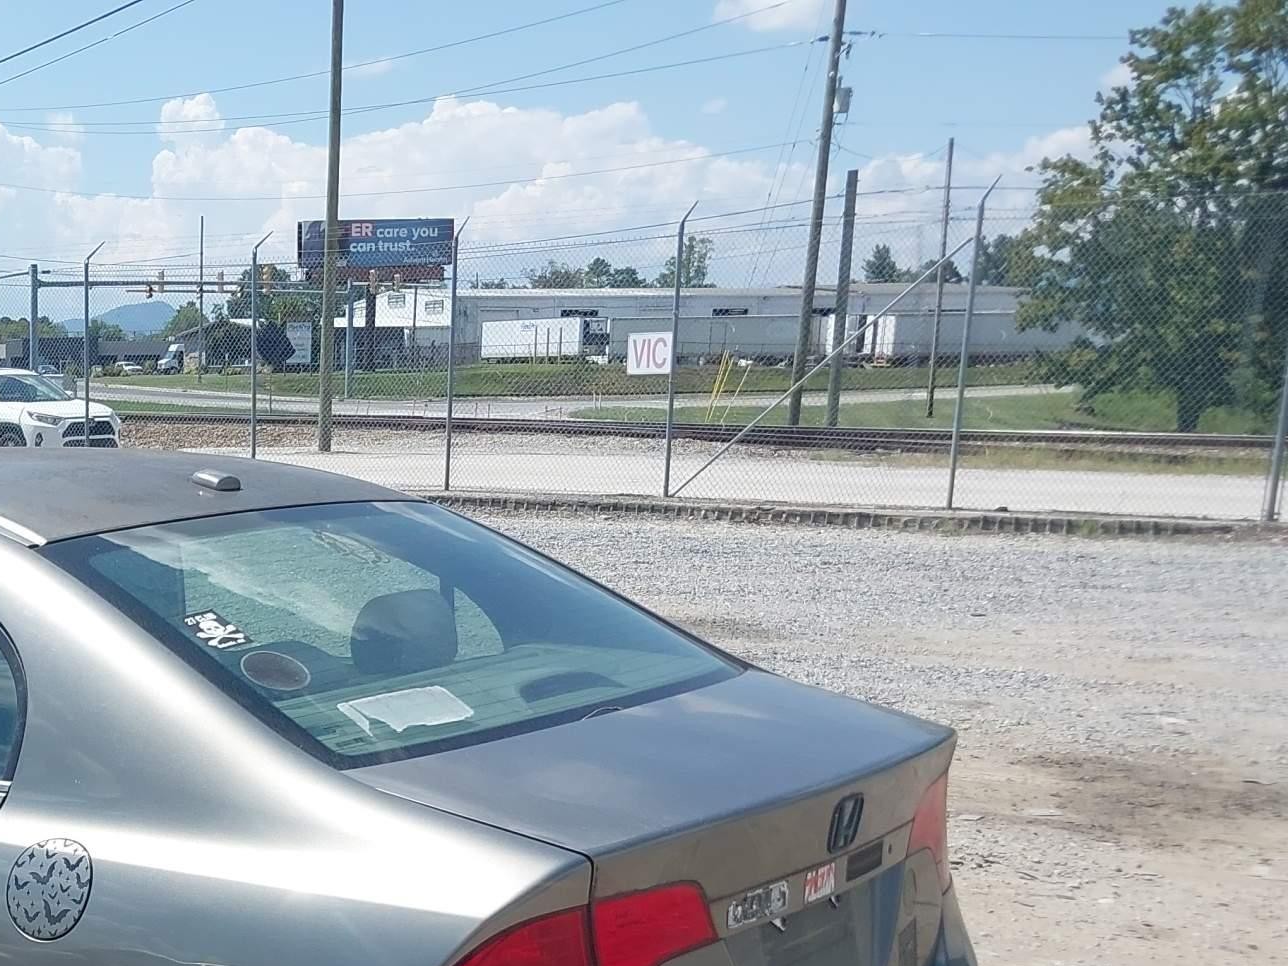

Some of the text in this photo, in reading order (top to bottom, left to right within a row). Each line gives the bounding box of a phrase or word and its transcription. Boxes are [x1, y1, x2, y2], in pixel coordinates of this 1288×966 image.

[351, 222, 439, 240] ER care you
[349, 239, 416, 252] can trust.
[632, 337, 668, 369] VIC
